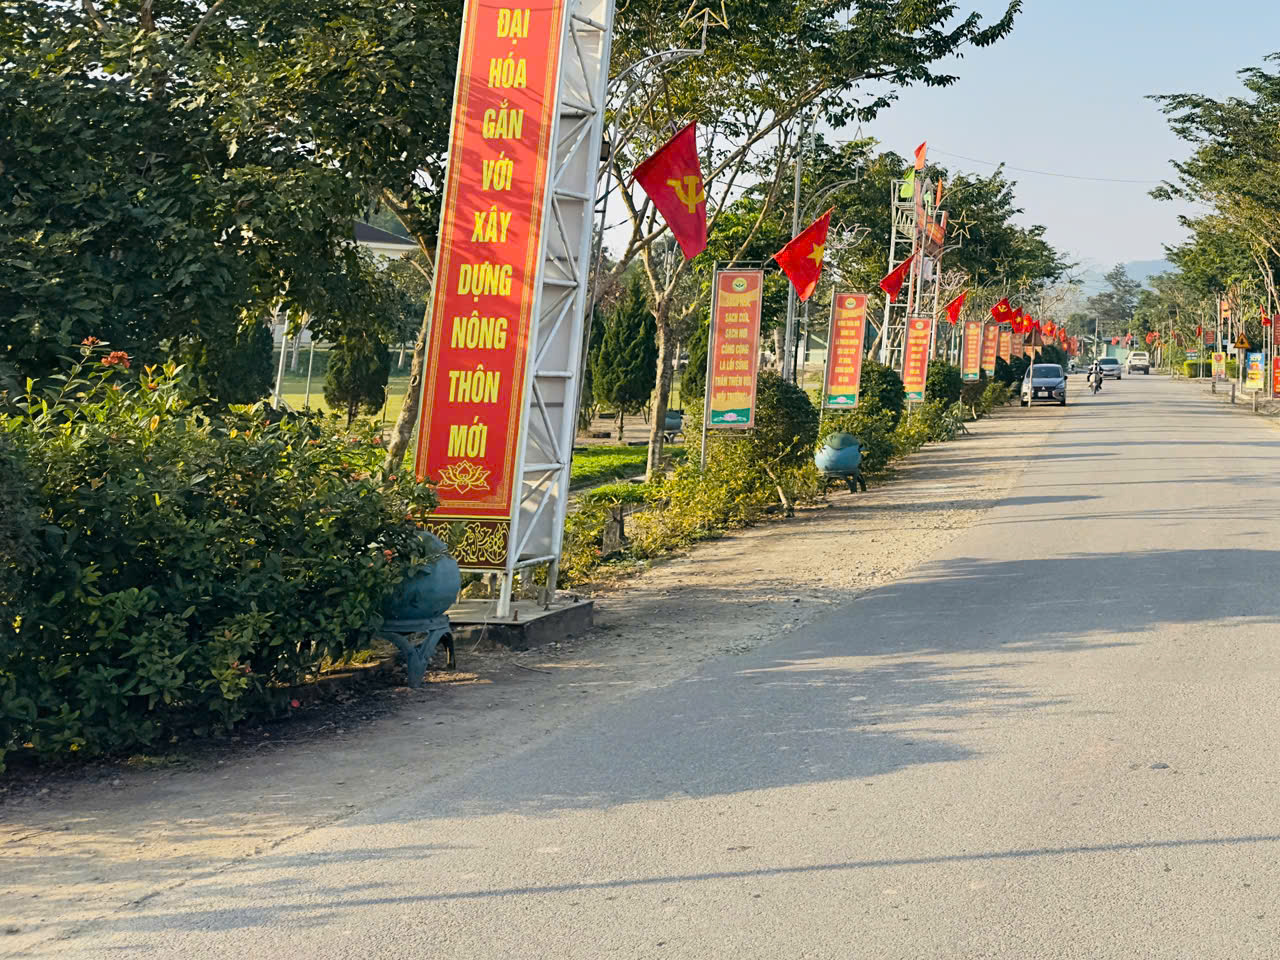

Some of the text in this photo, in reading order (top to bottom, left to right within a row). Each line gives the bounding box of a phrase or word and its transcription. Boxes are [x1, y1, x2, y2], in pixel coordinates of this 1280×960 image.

[496, 8, 530, 44] ĐẠI
[488, 49, 527, 89] HÓA
[482, 97, 524, 140] GẮN
[482, 152, 514, 192] VỚI
[471, 204, 512, 243] XÂY
[457, 261, 513, 302] DỰNG
[451, 310, 508, 350] NÔNG
[448, 364, 500, 404] THÔN
[447, 416, 488, 458] MỚI
